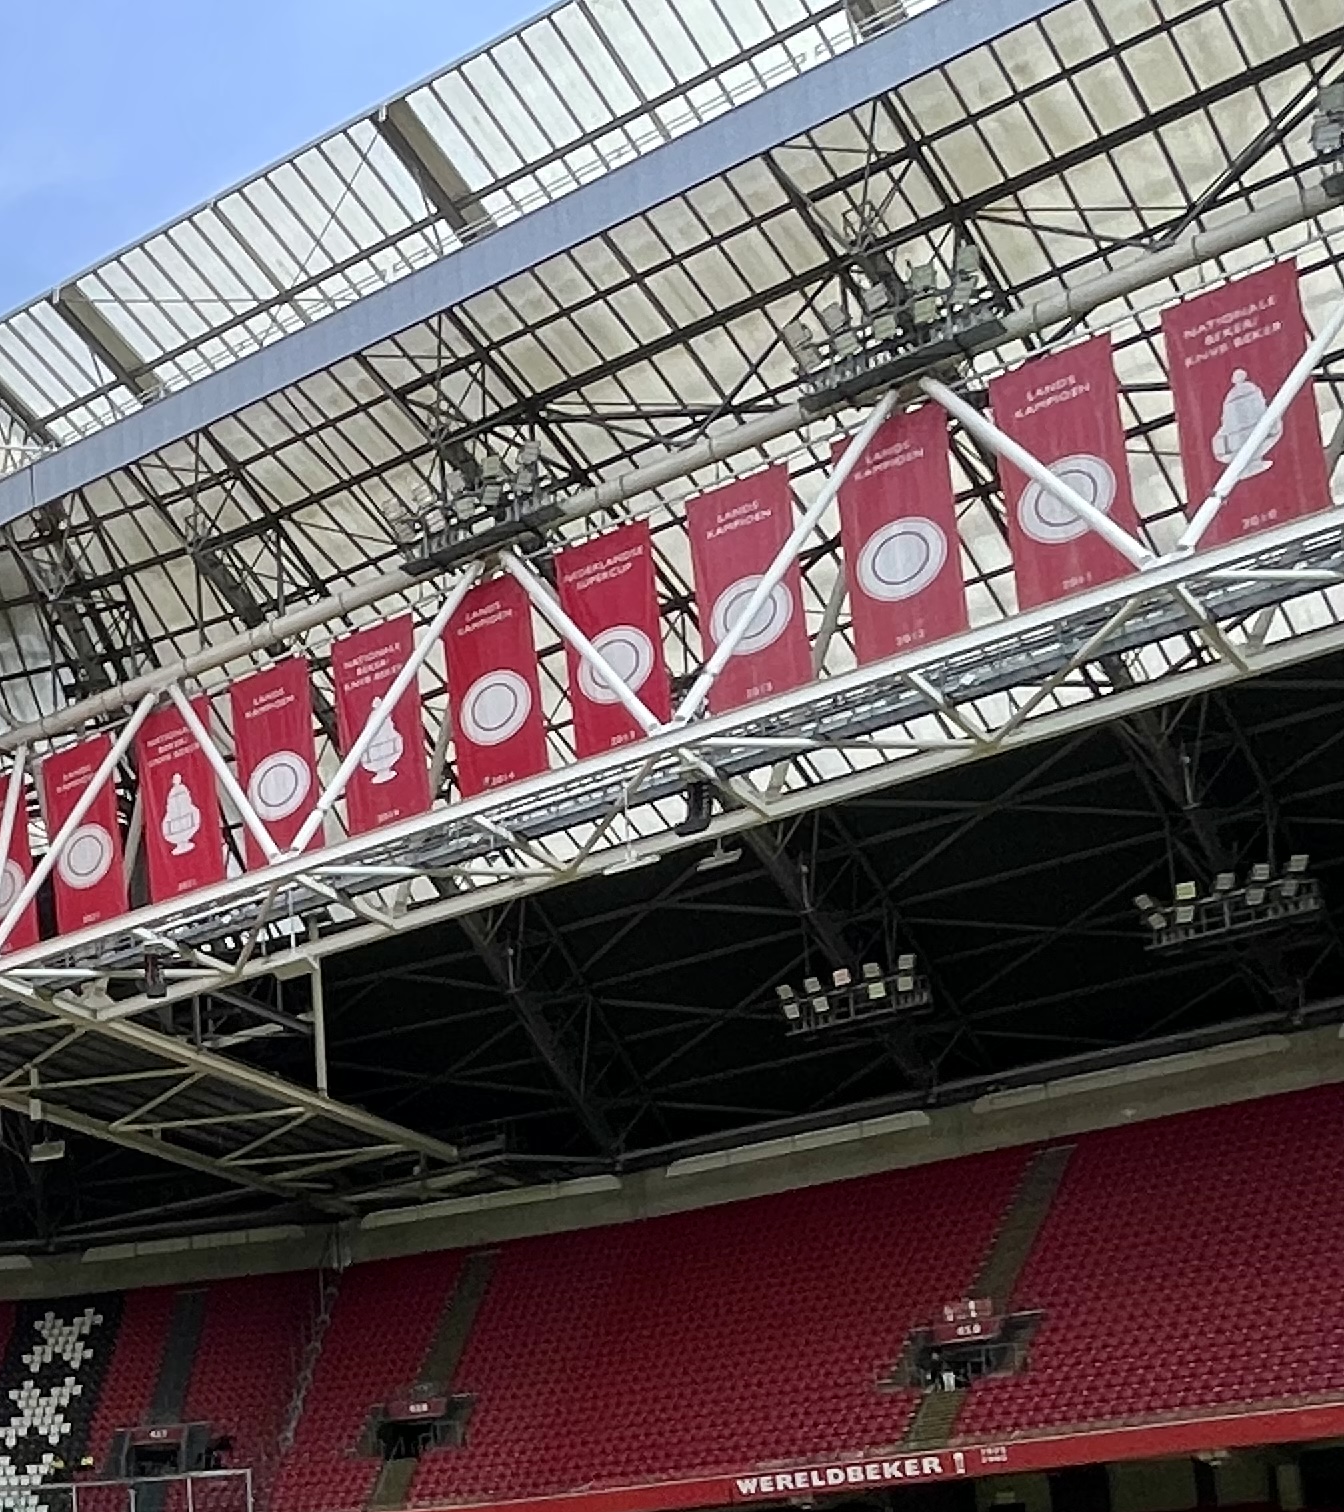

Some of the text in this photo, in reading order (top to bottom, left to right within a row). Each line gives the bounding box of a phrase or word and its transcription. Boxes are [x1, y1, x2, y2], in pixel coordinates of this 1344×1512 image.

[1183, 295, 1277, 339] NATIONALE
[1015, 383, 1090, 418] KAMPIOEN
[1026, 374, 1076, 400] LANDS
[706, 509, 772, 539] KAMPIOEN
[737, 1456, 943, 1494] WERELDBEKER
